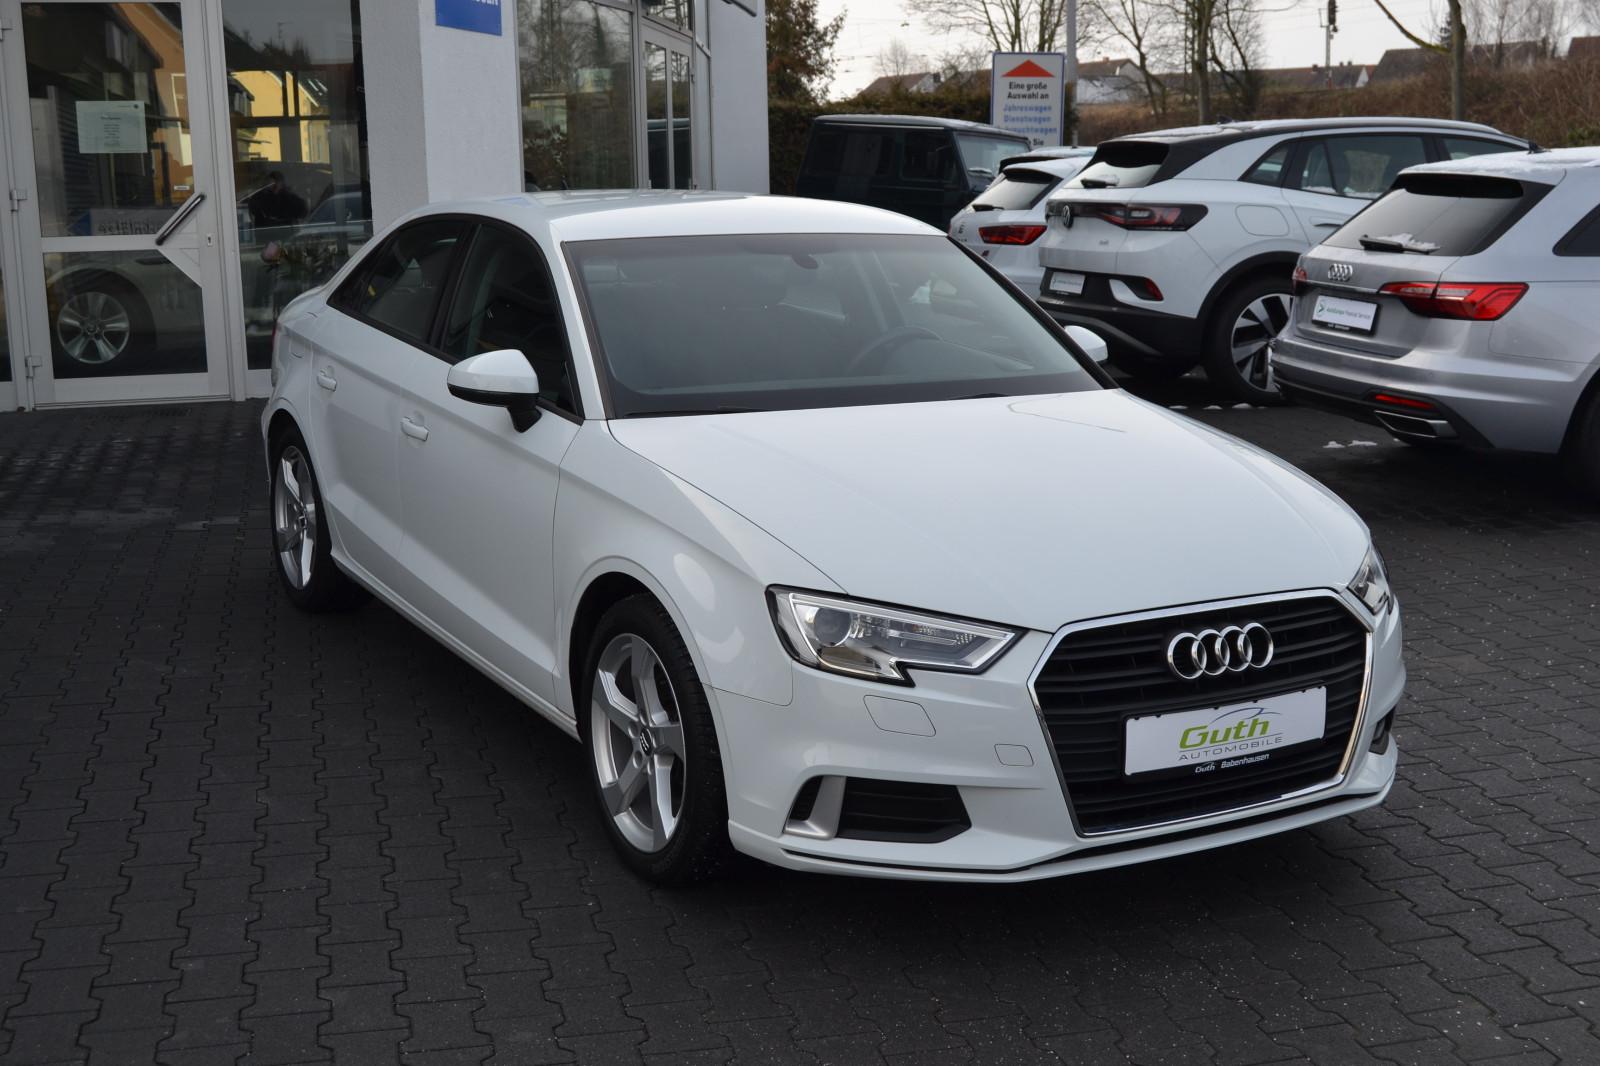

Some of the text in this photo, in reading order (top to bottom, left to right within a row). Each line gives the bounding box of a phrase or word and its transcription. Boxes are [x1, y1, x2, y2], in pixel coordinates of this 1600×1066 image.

[1009, 81, 1047, 91] Eine große
[1003, 104, 1052, 113] Jahreswagen
[1003, 115, 1051, 124] Dienstwagen
[1179, 717, 1269, 749] Guth
[1178, 736, 1283, 761] AUTOMOBILE
[1195, 753, 1270, 773] Guth Babenhausen
